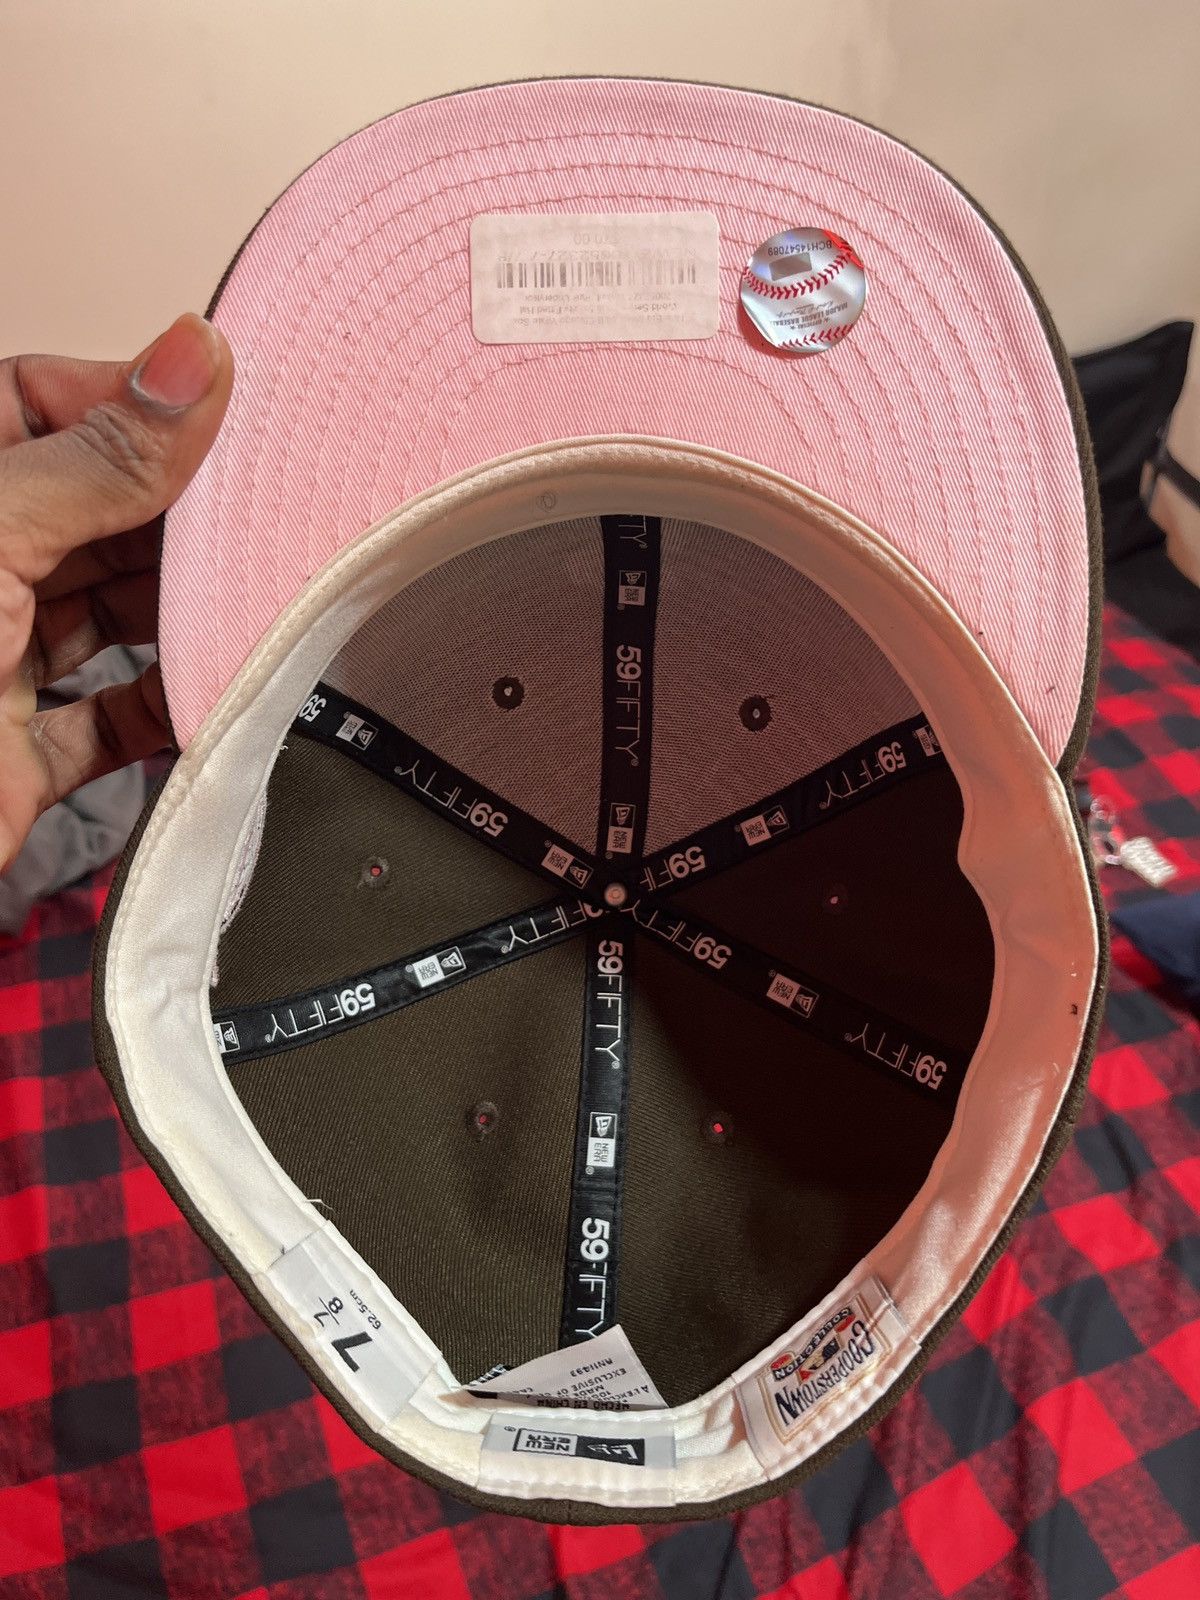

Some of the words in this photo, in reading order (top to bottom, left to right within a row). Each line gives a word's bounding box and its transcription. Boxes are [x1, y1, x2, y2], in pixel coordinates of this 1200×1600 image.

[767, 240, 833, 257] BCH14547089
[801, 310, 825, 322] LEAGUE
[826, 302, 848, 316] MAJOR
[595, 940, 623, 1062] 59FIFTY
[269, 983, 376, 1042] 59FIFTY
[600, 1142, 609, 1163] NEW
[349, 1289, 382, 1330] 62.5cm
[571, 1367, 627, 1392] EXCLUSIVE
[774, 1319, 875, 1426] COOPERSTOWN
[525, 1439, 571, 1452] NEW
[526, 1433, 571, 1445] ERA
